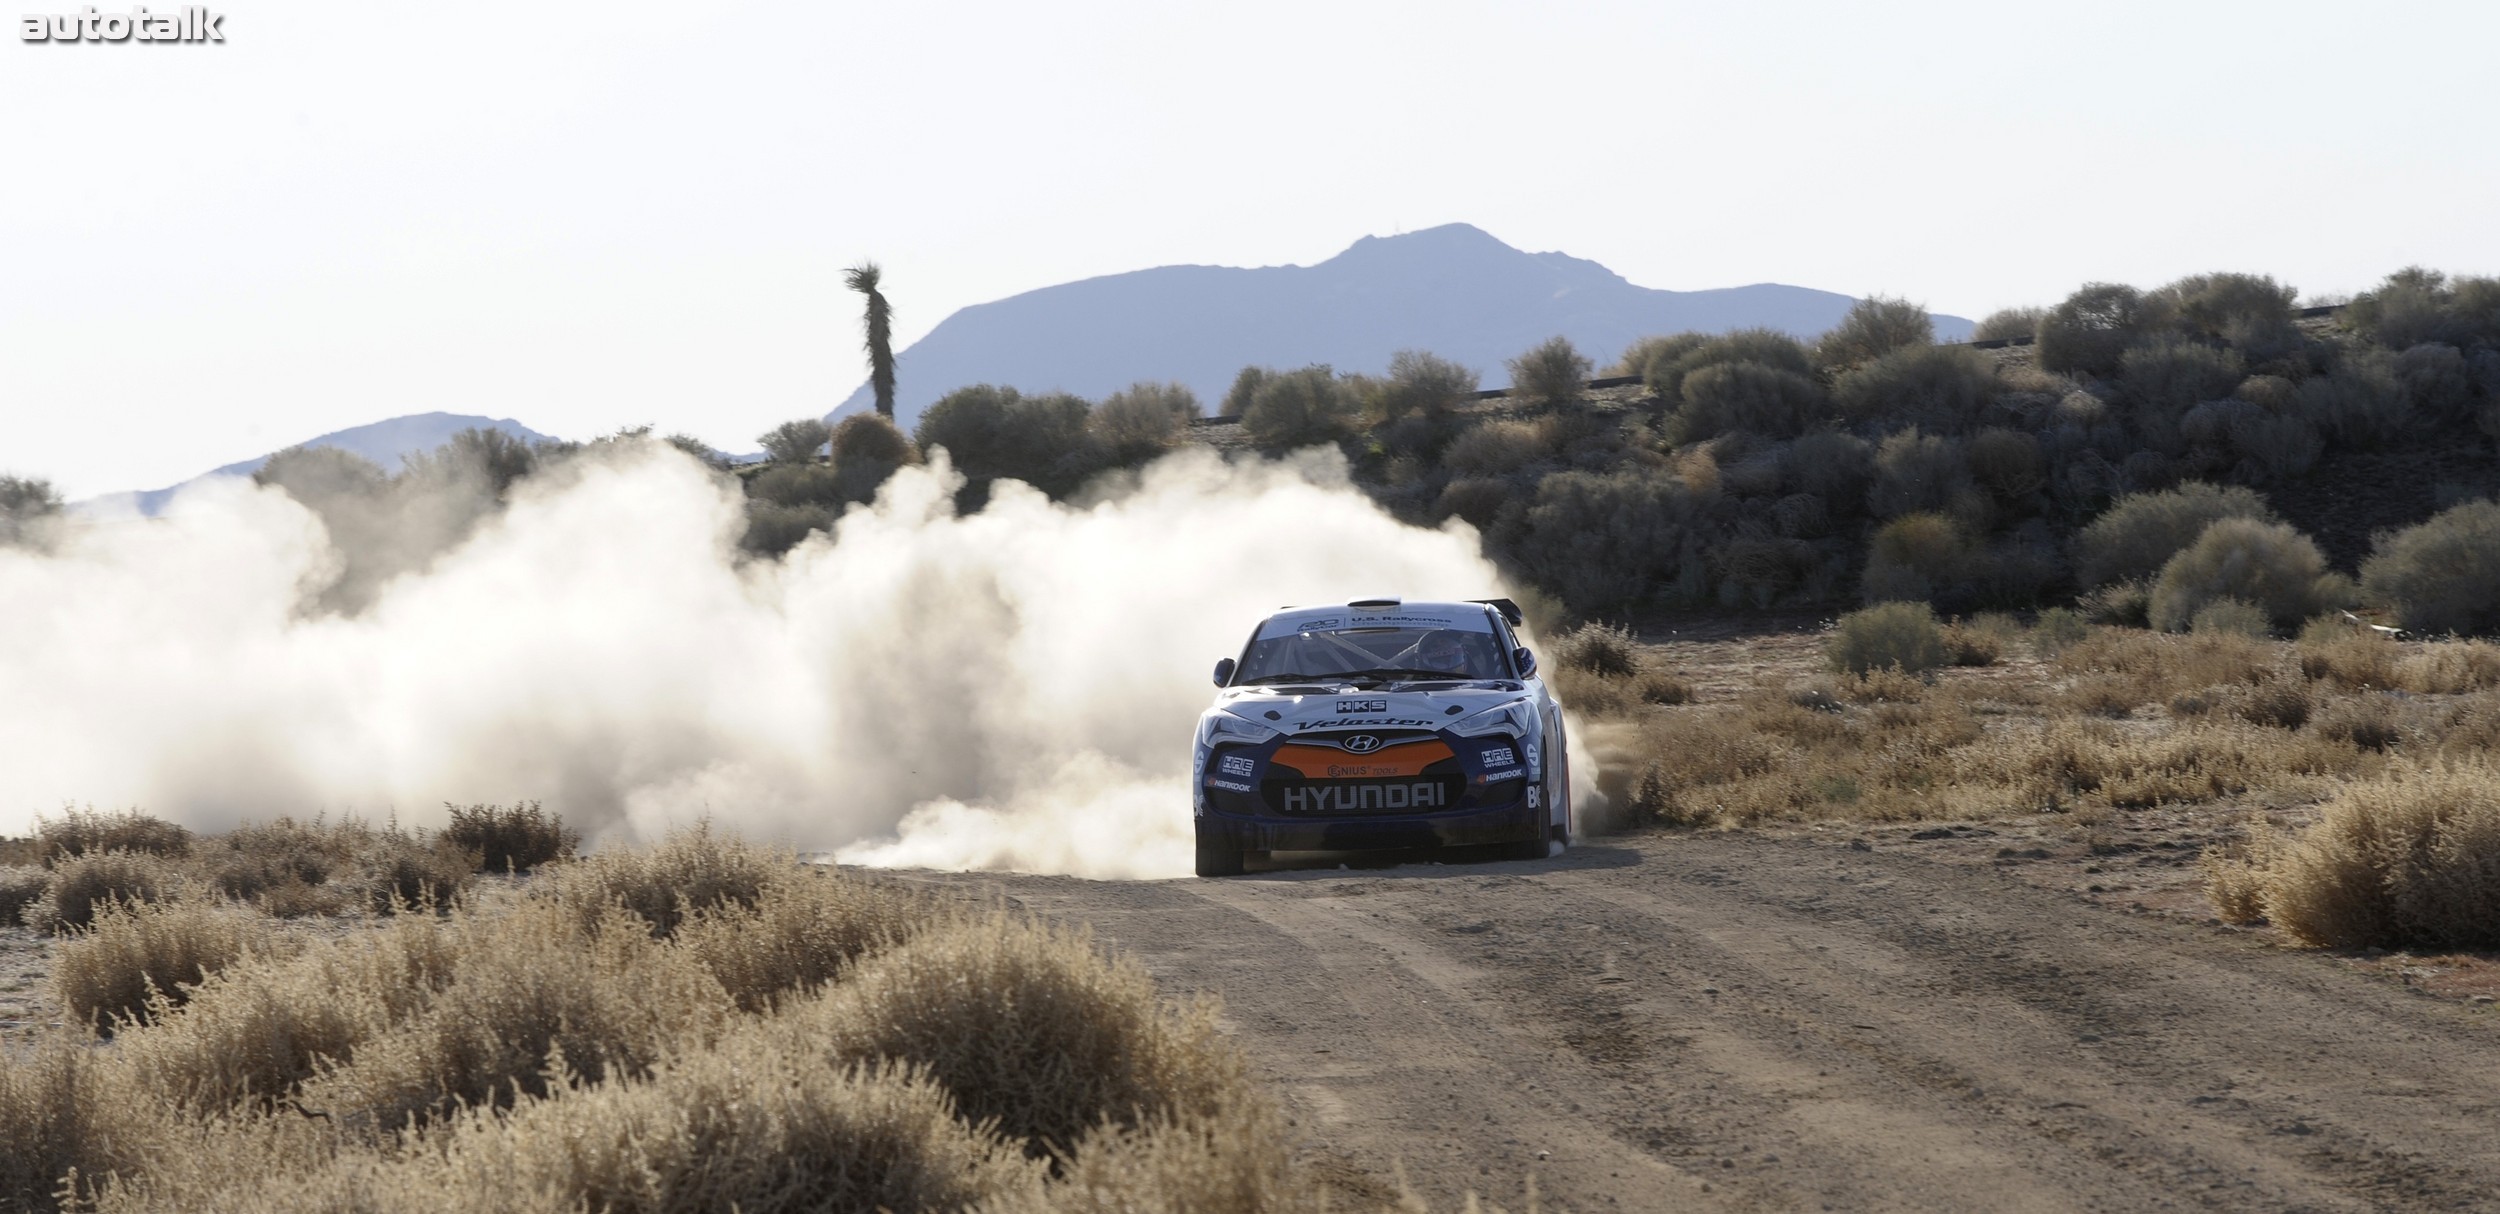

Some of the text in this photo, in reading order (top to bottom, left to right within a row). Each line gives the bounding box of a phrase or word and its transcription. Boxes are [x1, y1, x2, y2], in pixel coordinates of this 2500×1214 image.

[1337, 700, 1387, 714] HKS
[1481, 747, 1514, 763] HRE
[1222, 755, 1255, 772] HRE
[1484, 760, 1516, 768] WHEELS
[1222, 767, 1251, 777] WHEELS
[1284, 782, 1445, 811] HYUNDAI
